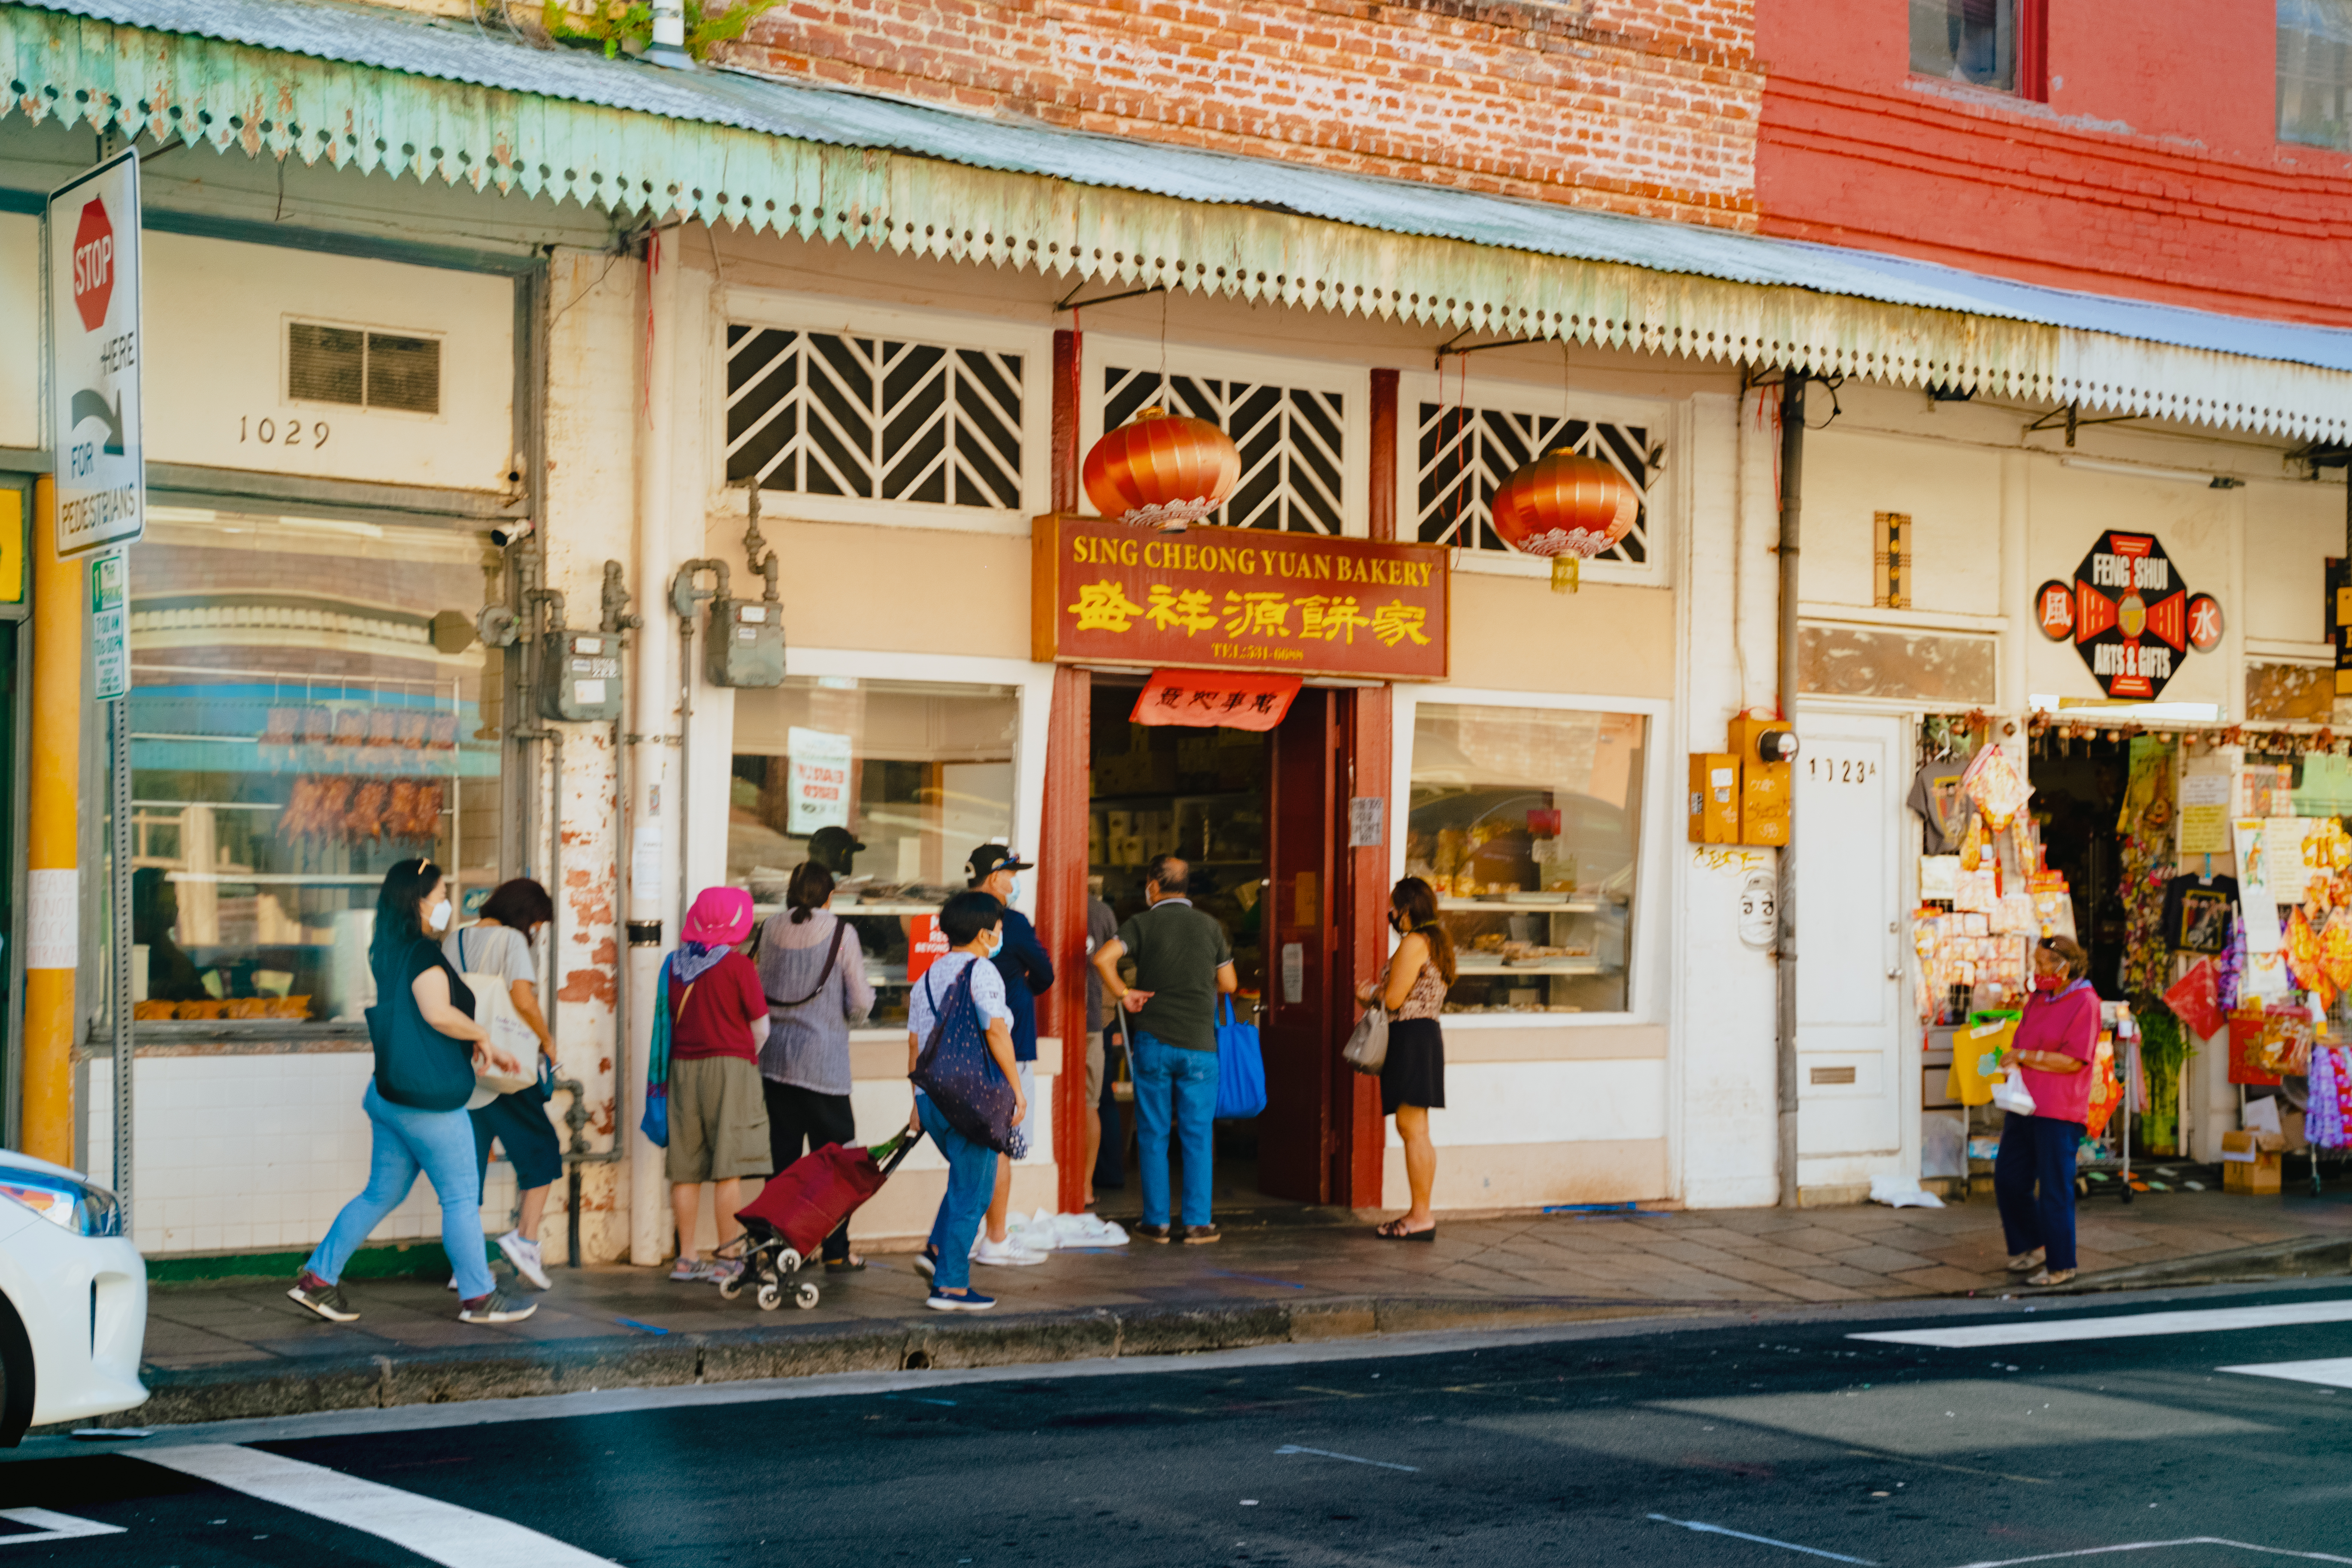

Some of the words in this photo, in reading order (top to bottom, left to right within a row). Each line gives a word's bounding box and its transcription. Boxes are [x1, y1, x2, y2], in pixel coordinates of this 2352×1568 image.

[75, 235, 112, 296] STOP
[100, 331, 135, 376] HERE
[239, 415, 330, 450] 1029
[71, 441, 94, 480] FOR
[62, 482, 135, 536] PEDESTRIANS
[1073, 535, 1138, 566] SING
[1144, 541, 1256, 575] CHEONG
[1259, 549, 1332, 580] YUAN
[1336, 555, 1433, 587] BAKERY
[2092, 552, 2130, 587] FENG
[2134, 556, 2168, 590] SHUI
[2043, 590, 2072, 627] 風
[2191, 601, 2218, 640] 水
[2094, 643, 2125, 676] ARTS
[2126, 645, 2138, 677] &
[2138, 645, 2171, 679] GIFTS
